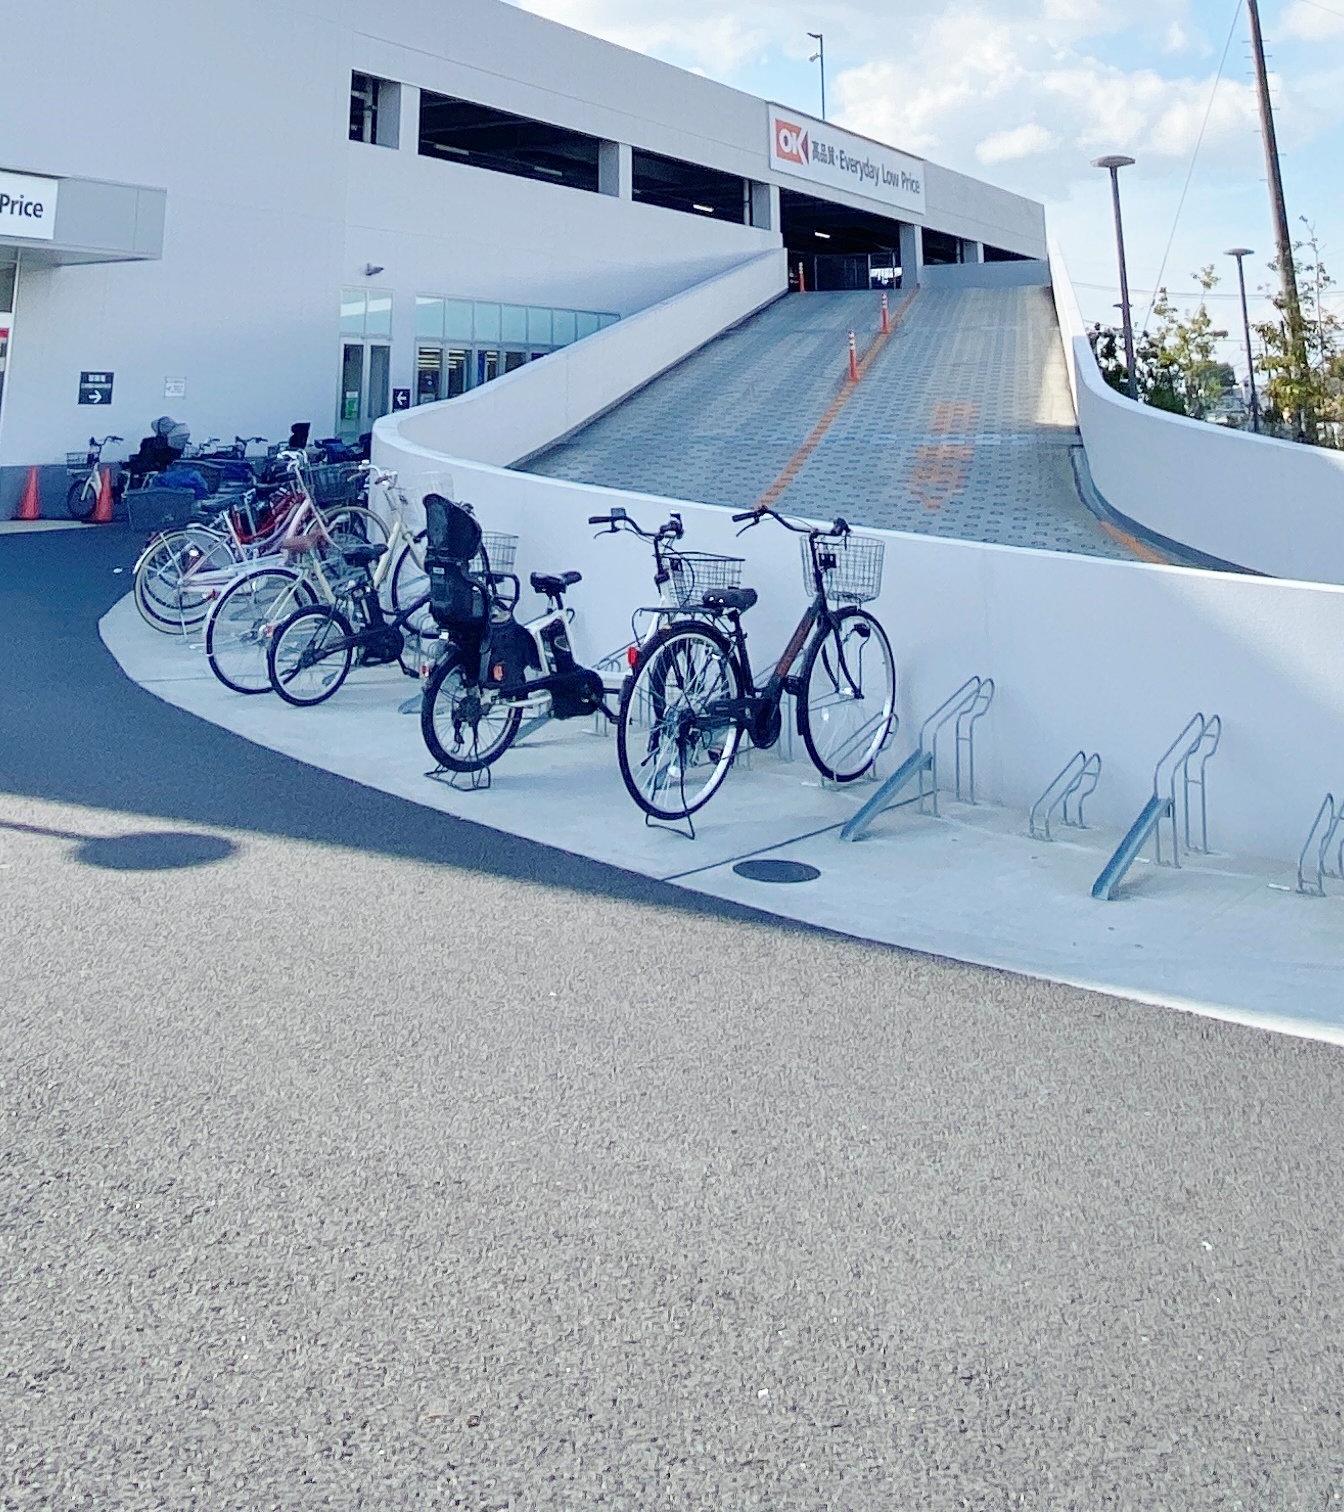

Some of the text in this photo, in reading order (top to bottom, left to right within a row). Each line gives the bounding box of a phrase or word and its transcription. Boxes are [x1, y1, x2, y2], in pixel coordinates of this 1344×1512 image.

[779, 127, 810, 165] OK
[881, 164, 900, 188] Low
[901, 171, 921, 194] Price
